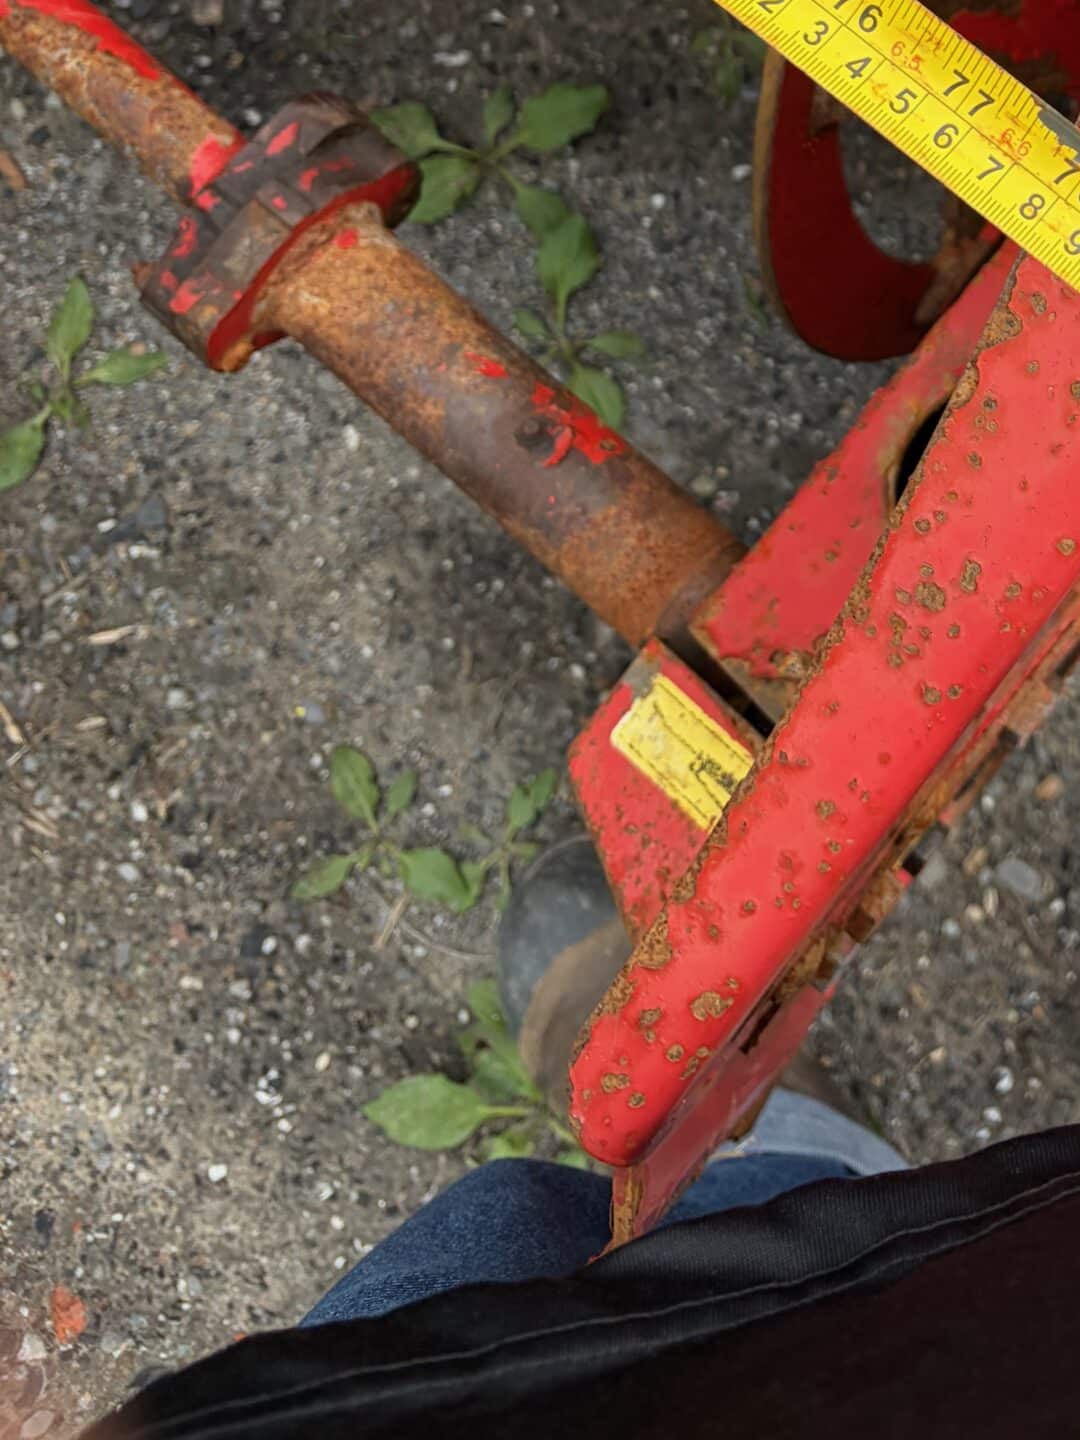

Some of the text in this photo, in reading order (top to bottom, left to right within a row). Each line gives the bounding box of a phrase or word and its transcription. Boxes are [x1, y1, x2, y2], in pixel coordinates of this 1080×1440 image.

[802, 20, 830, 47] 3
[844, 56, 873, 81] 4
[888, 87, 919, 115] 5
[932, 123, 960, 150] 6
[975, 154, 1006, 182] 7
[1018, 193, 1046, 222] 8
[942, 68, 996, 118] 77
